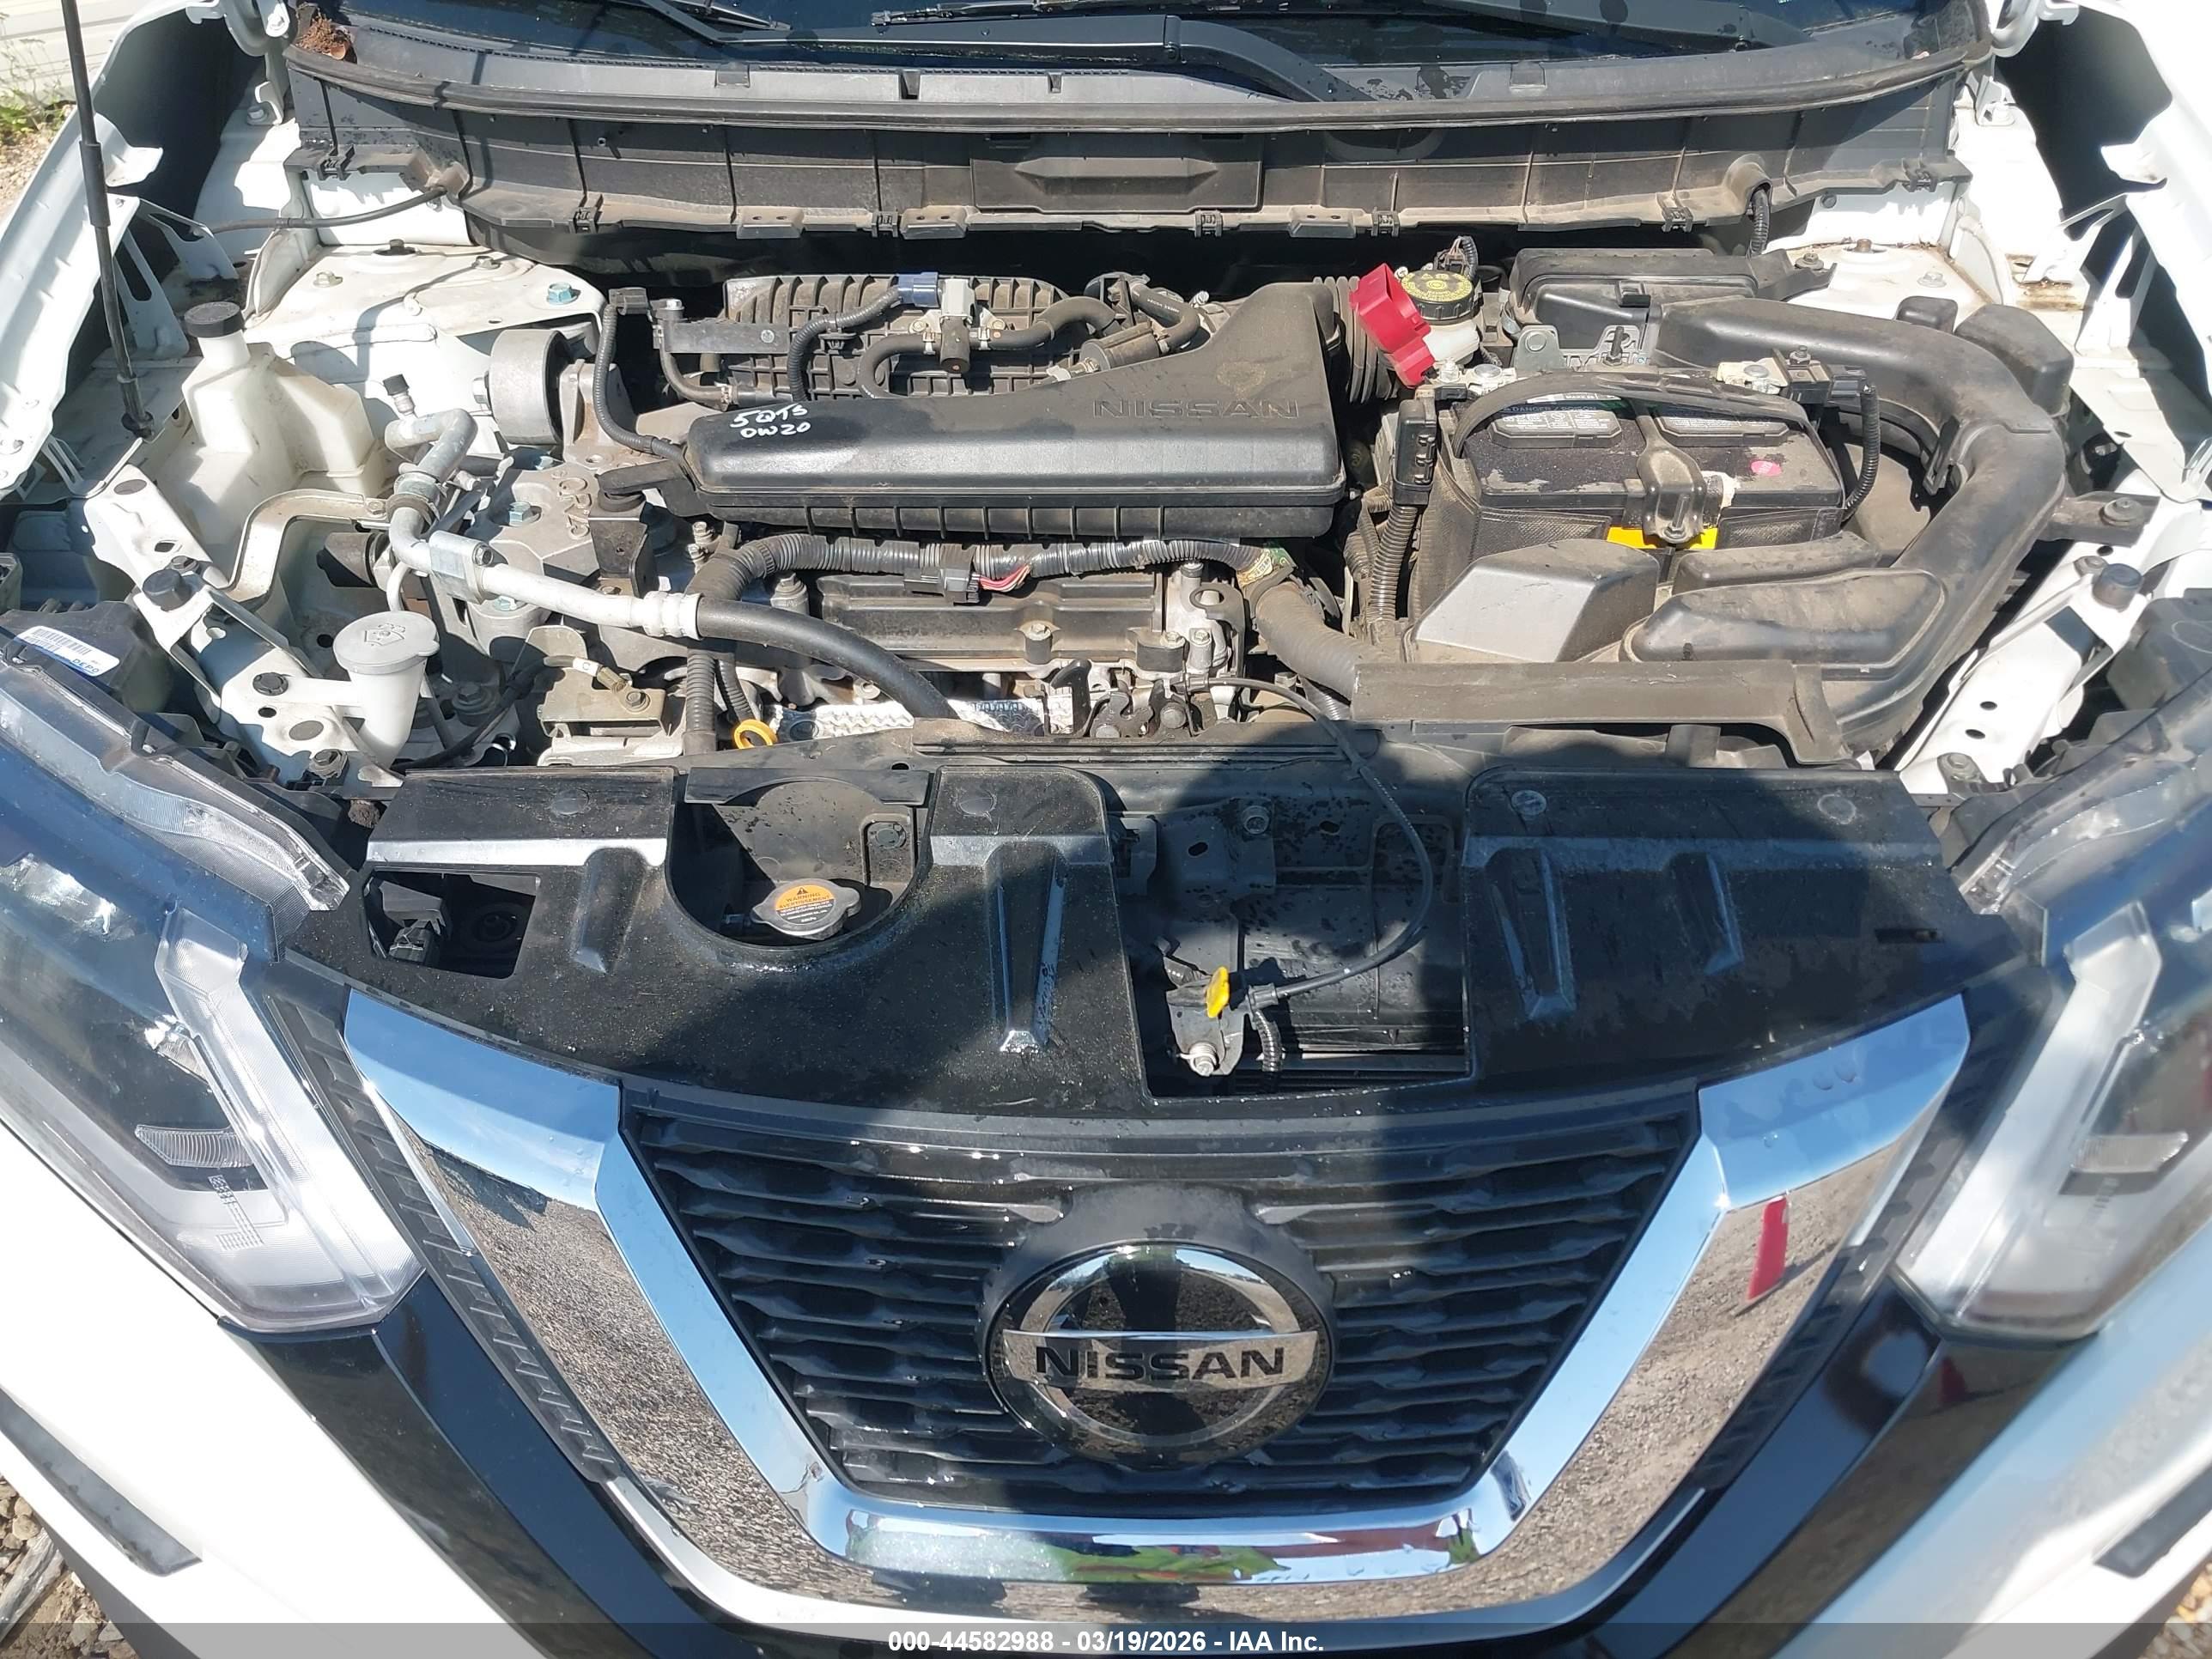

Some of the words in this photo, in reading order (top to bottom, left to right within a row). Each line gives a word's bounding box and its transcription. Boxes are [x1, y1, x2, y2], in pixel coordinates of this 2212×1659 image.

[1093, 399, 1299, 419] NISSAN
[72, 658, 100, 674] DEPO
[779, 896, 830, 908] AVERTISSEMENT
[786, 892, 821, 902] WARNING
[1036, 1346, 1284, 1380] NISSAN
